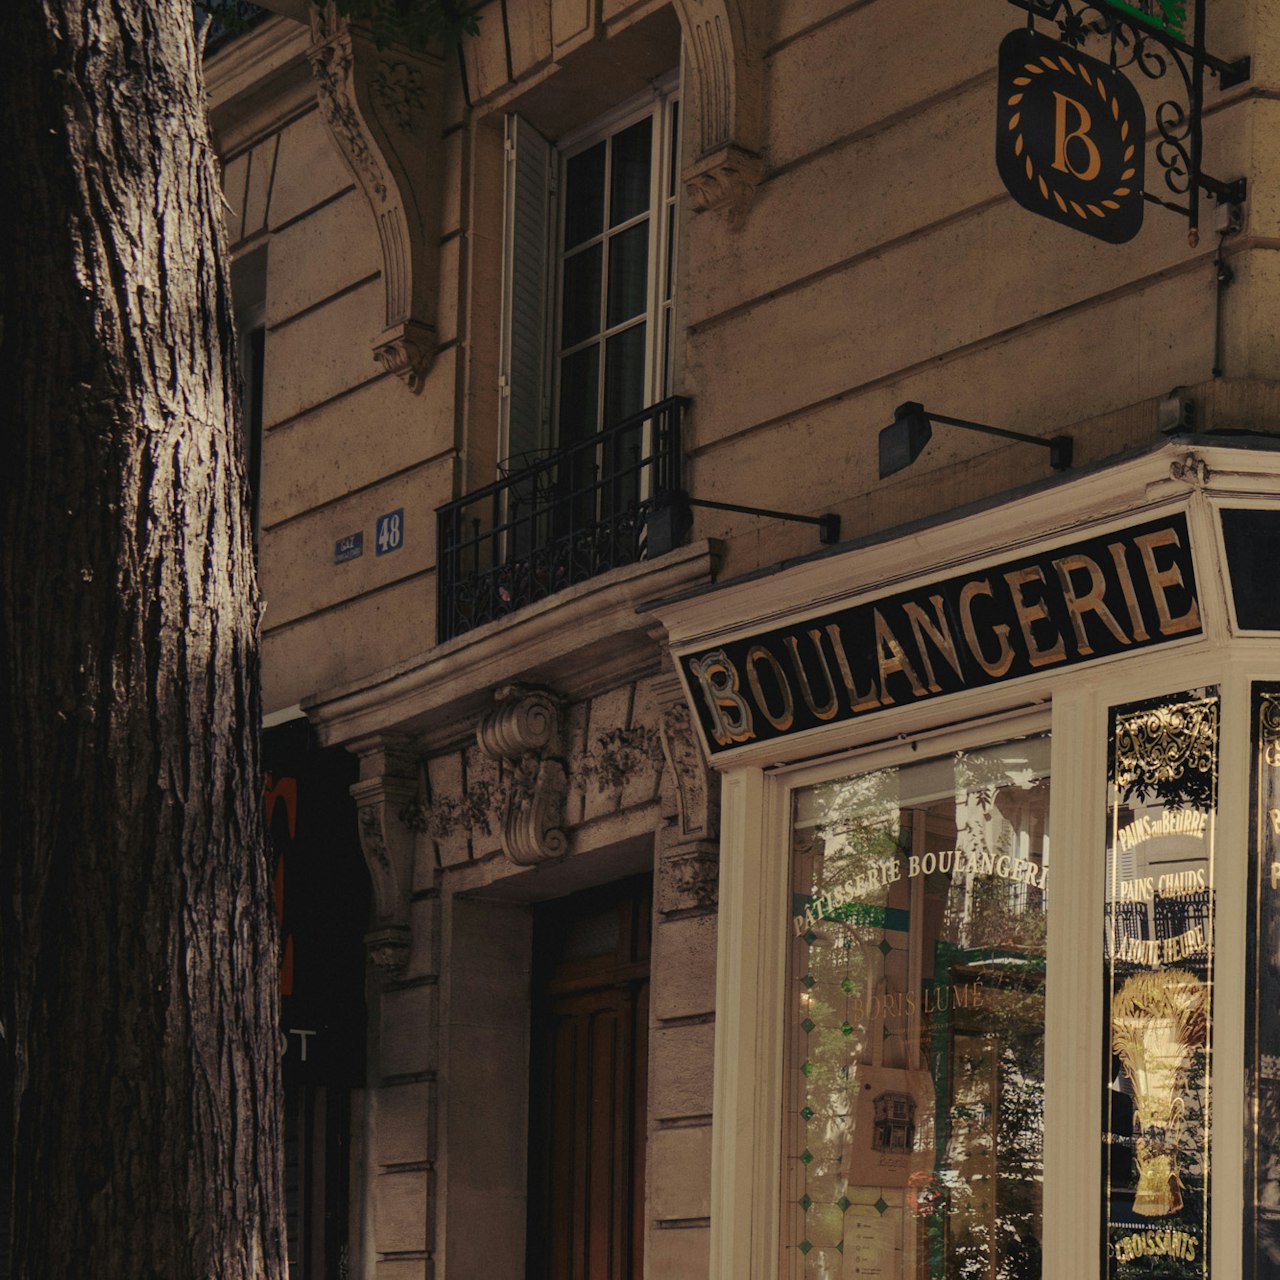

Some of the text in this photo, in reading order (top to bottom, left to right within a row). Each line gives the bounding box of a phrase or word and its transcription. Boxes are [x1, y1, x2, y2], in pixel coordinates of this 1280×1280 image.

[1051, 91, 1101, 181] B
[379, 514, 400, 551] 48
[691, 526, 1198, 746] BOULANGERIE
[1118, 809, 1208, 851] PAINS au BEURRE
[793, 850, 1049, 937] PÂTISSERIE BOULANGERI
[1120, 868, 1205, 903] PAINS CHAUDS
[1127, 937, 1161, 965] TOUTE
[1162, 925, 1206, 964] HEURE
[854, 976, 984, 1022] BORIS LUMÉ
[1115, 1231, 1199, 1264] CROISSANTS
